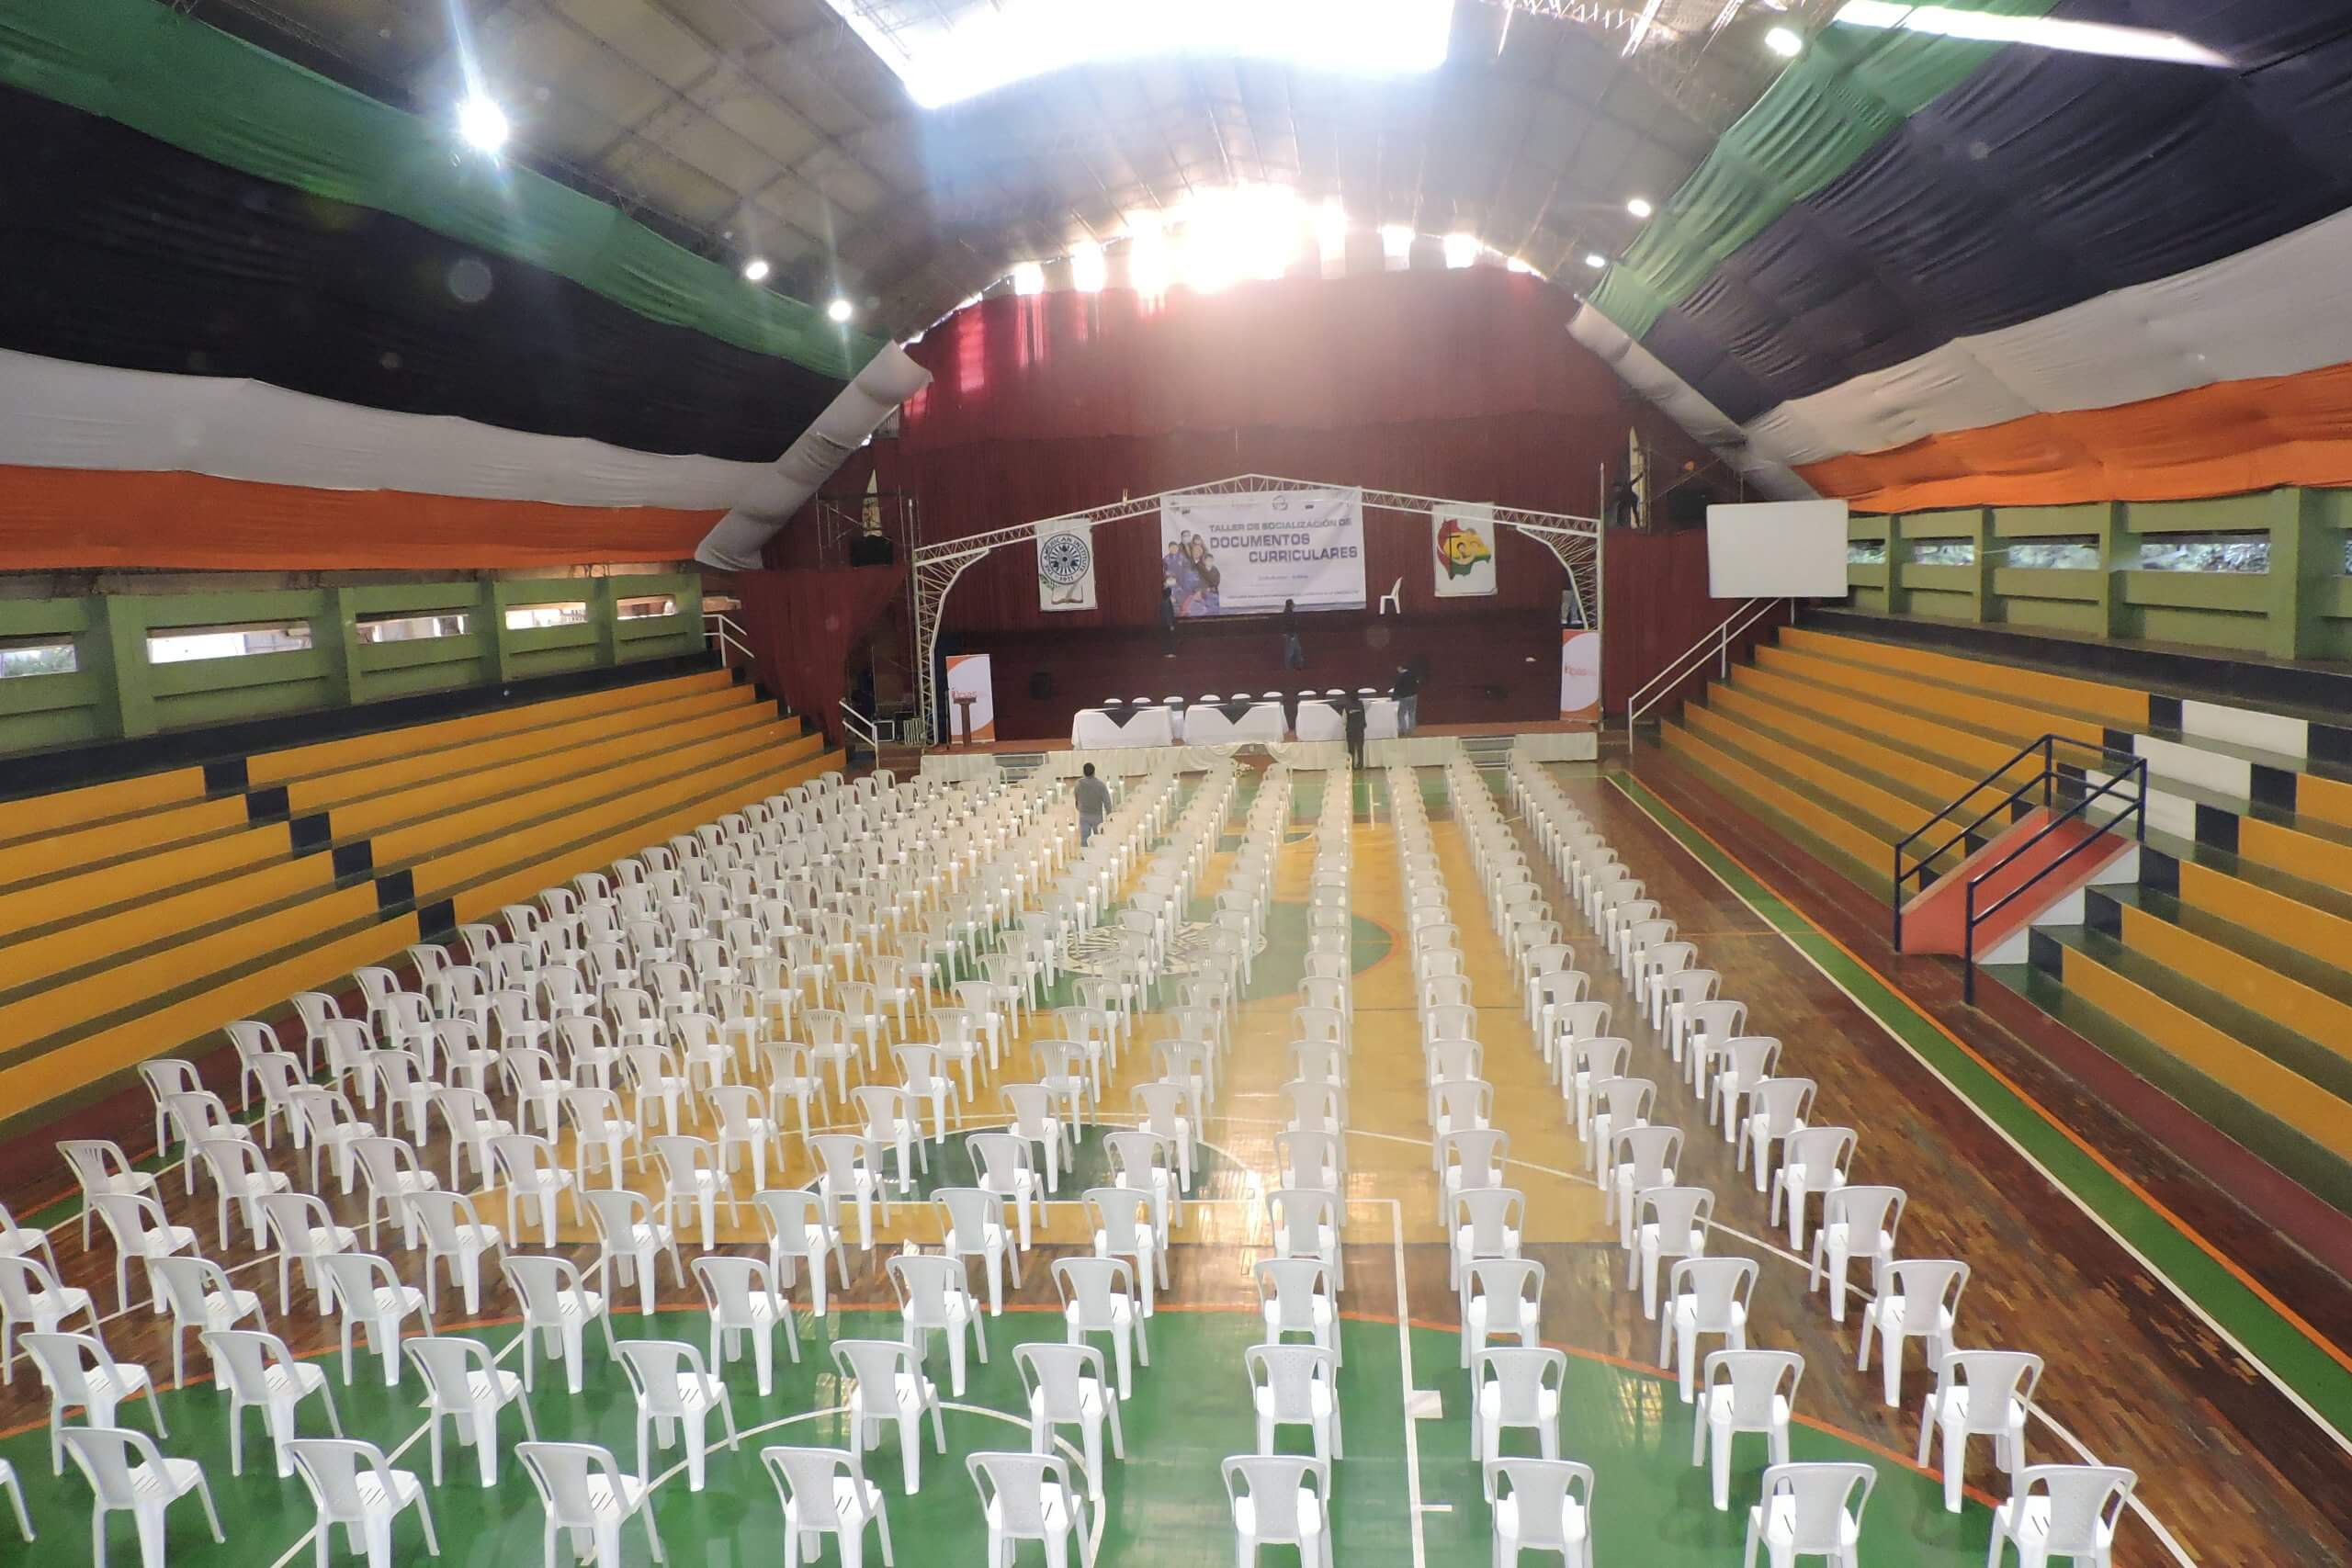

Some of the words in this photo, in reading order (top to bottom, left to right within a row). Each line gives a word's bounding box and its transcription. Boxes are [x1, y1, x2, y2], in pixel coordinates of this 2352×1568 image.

[1209, 523, 1245, 533] TALLER
[1247, 523, 1260, 531] DE
[1339, 518, 1351, 526] DE
[1210, 533, 1310, 548] DOCUMENTOS
[1044, 536, 1072, 559] AMERICAN
[1073, 540, 1087, 572] INSTITUTE
[1250, 546, 1358, 563] CURRICULARES
